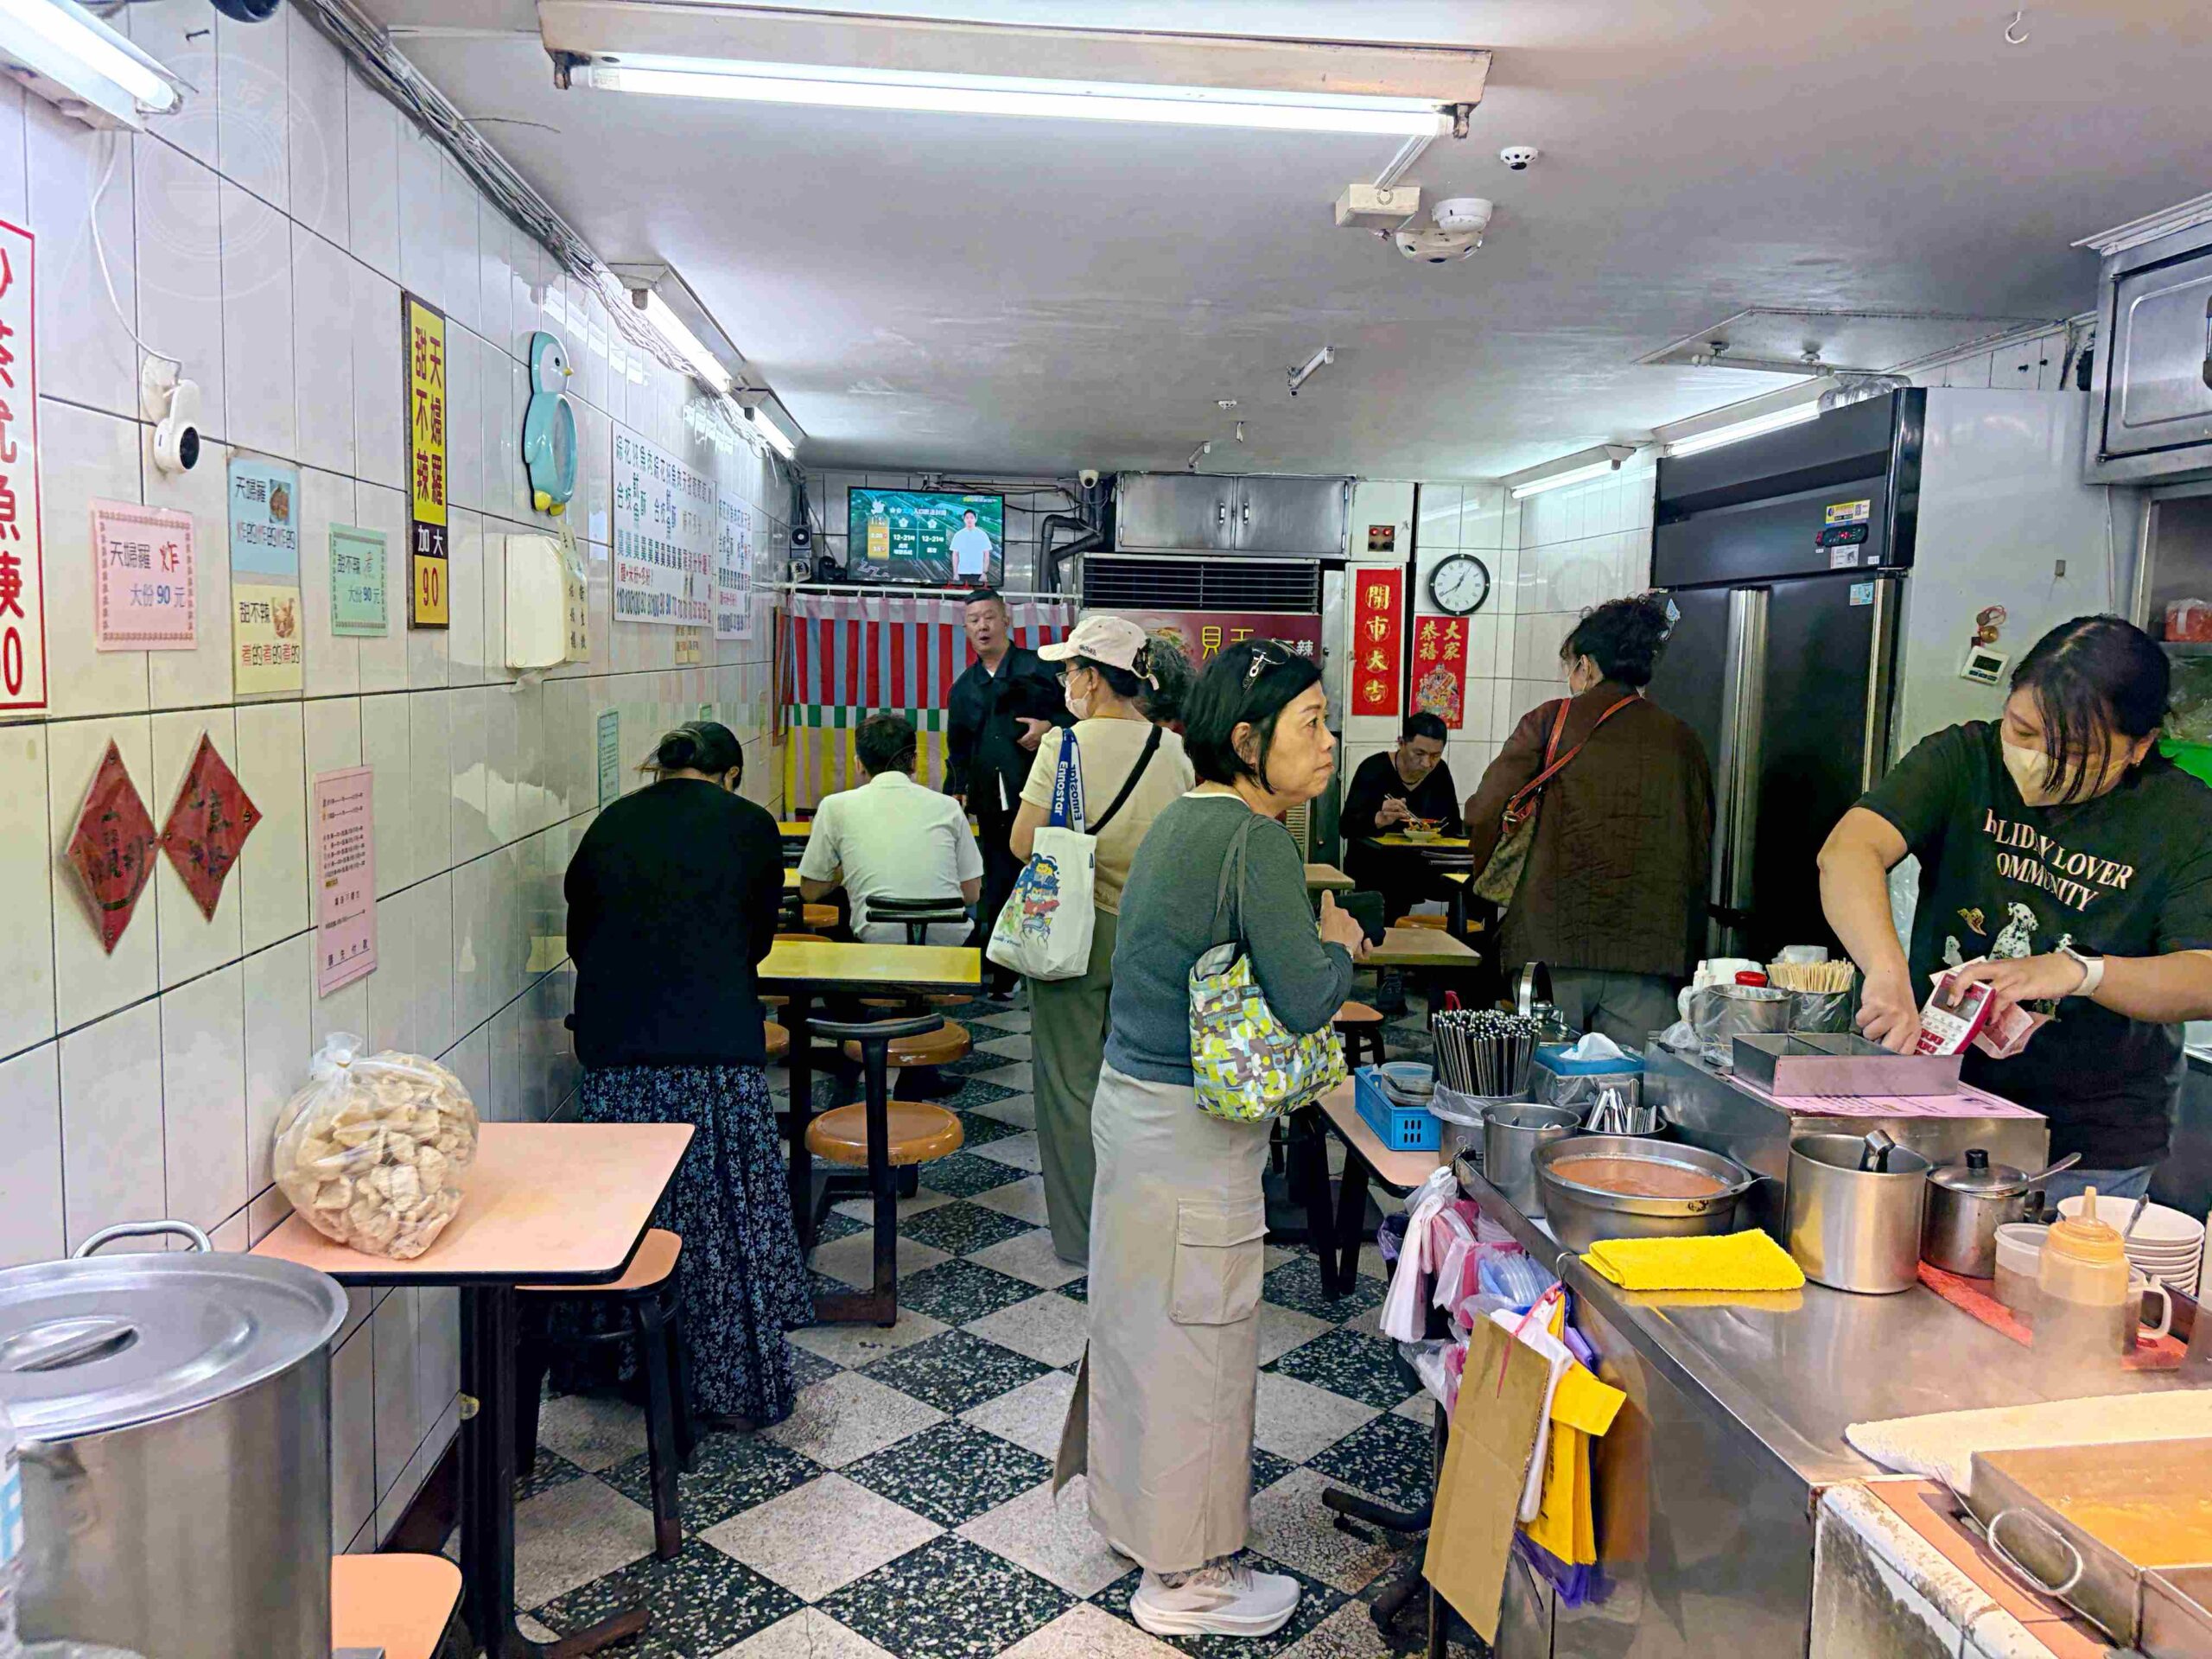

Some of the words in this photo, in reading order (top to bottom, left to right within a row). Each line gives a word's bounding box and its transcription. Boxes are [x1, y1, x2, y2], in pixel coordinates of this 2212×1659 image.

[415, 327, 429, 503] 甜不辣
[160, 541, 180, 573] 炸
[418, 524, 444, 556] 加大
[423, 566, 439, 607] 90
[1365, 584, 1390, 702] 開市大吉
[1054, 760, 1069, 817] Ennostar
[2051, 845, 2134, 890] LOVER
